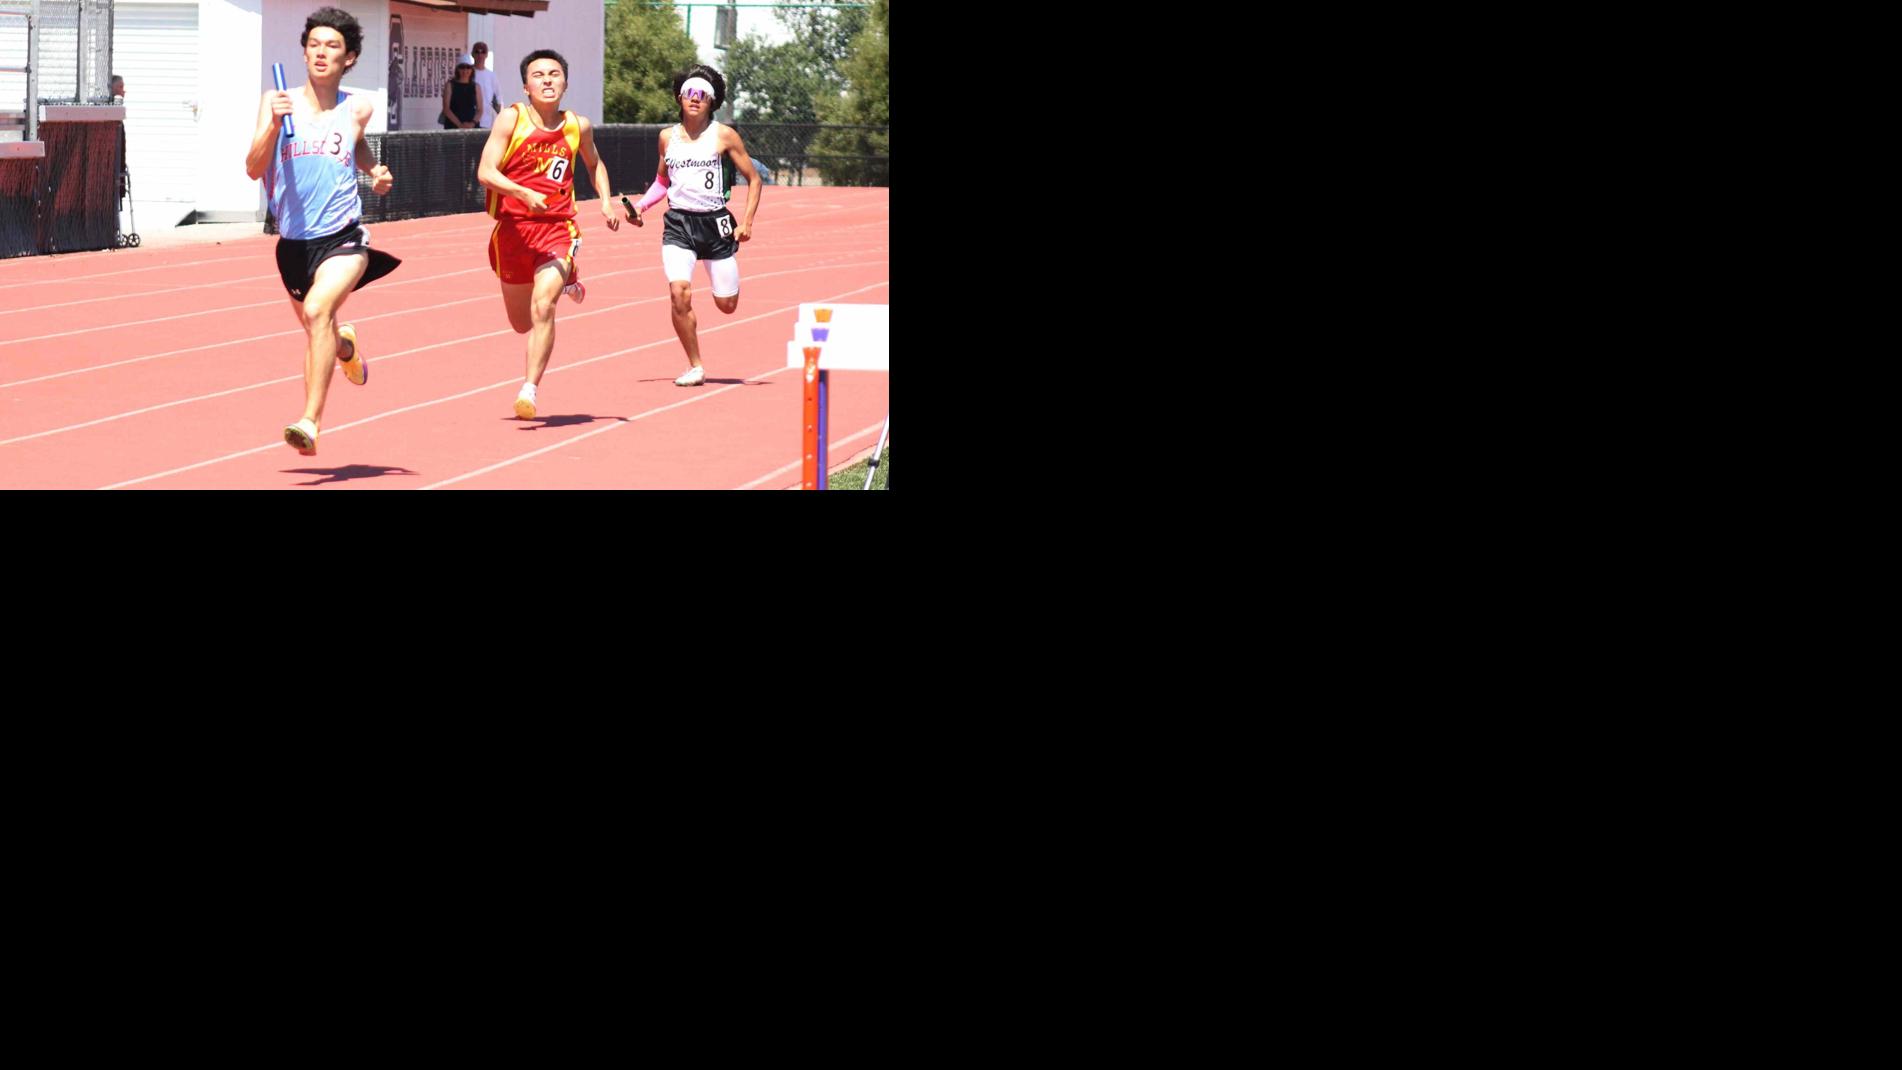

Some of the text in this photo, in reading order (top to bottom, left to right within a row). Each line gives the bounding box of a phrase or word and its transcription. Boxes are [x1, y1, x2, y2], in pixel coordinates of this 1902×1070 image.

[403, 46, 461, 98] LACROSS
[330, 132, 342, 155] 3
[527, 142, 567, 157] MILLS
[552, 159, 565, 180] 6
[704, 171, 714, 190] 8
[720, 218, 730, 236] 8
